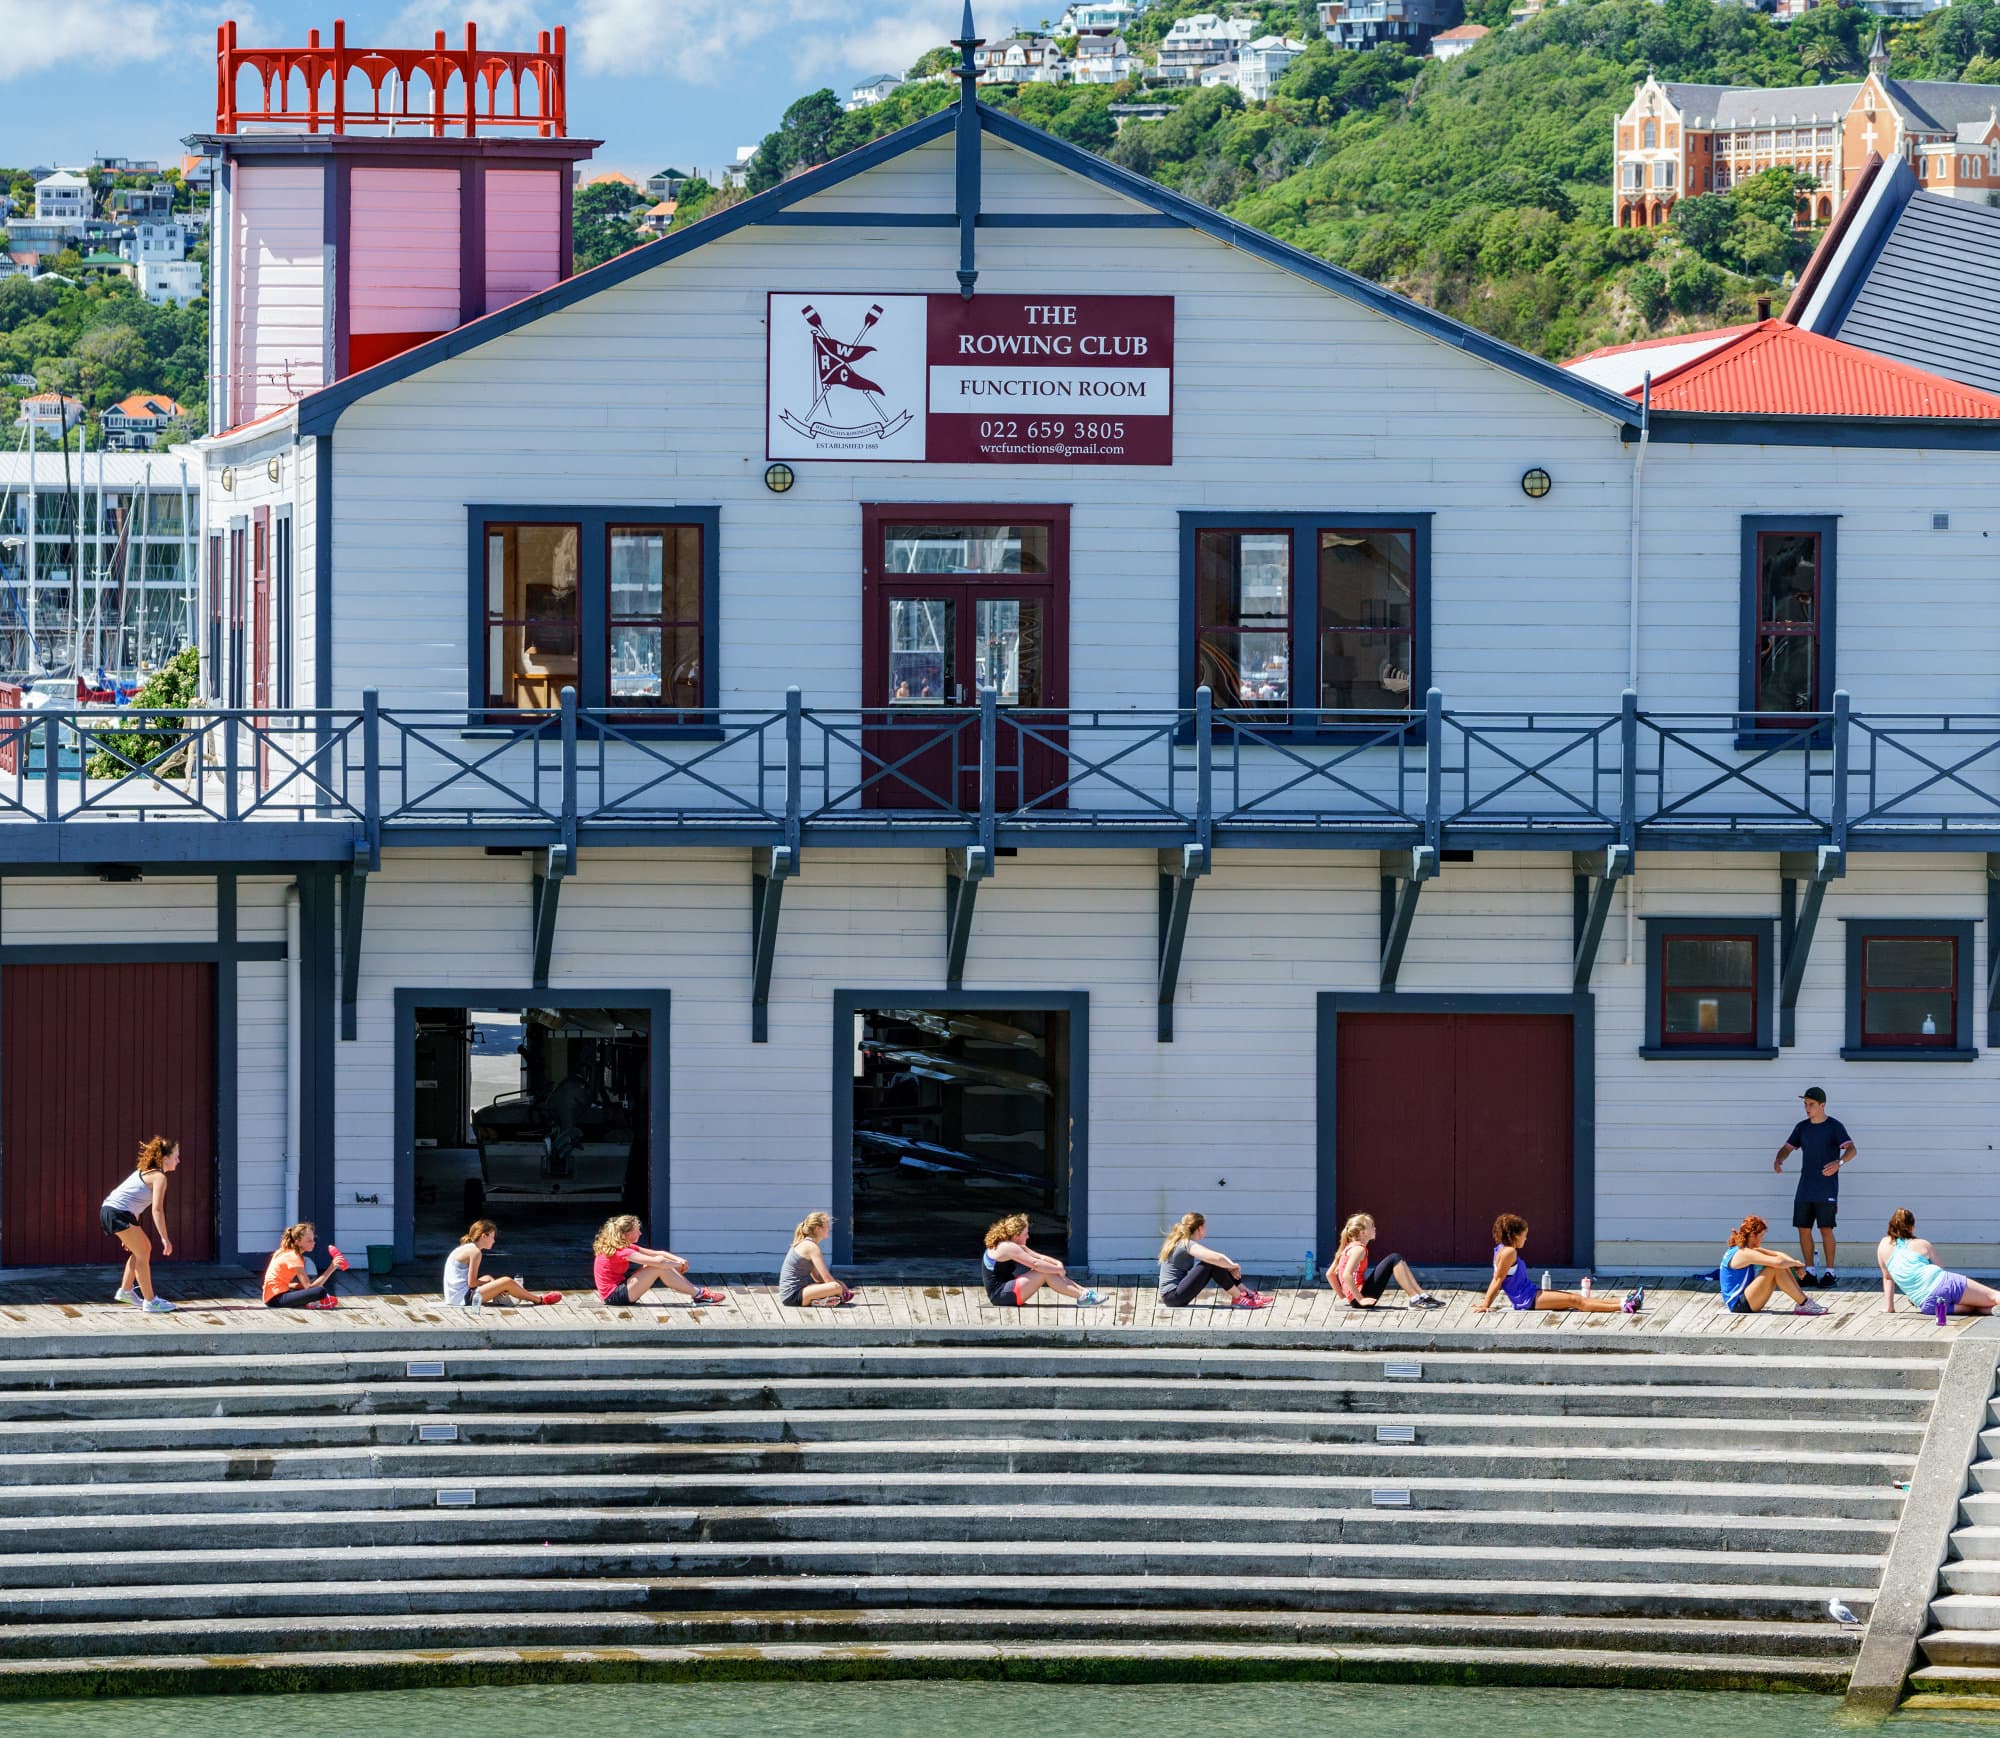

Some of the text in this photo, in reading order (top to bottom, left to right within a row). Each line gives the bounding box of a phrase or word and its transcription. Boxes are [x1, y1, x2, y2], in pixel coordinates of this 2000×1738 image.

[1024, 305, 1077, 325] THE
[836, 343, 854, 358] W
[958, 334, 1148, 356] ROWING CLUB
[821, 354, 831, 370] R
[840, 368, 849, 382] C
[959, 379, 1146, 397] FUNCTION ROOM
[980, 421, 1124, 439] 022 659 3805
[980, 442, 1124, 457] wrcfunctions@gmail.com
